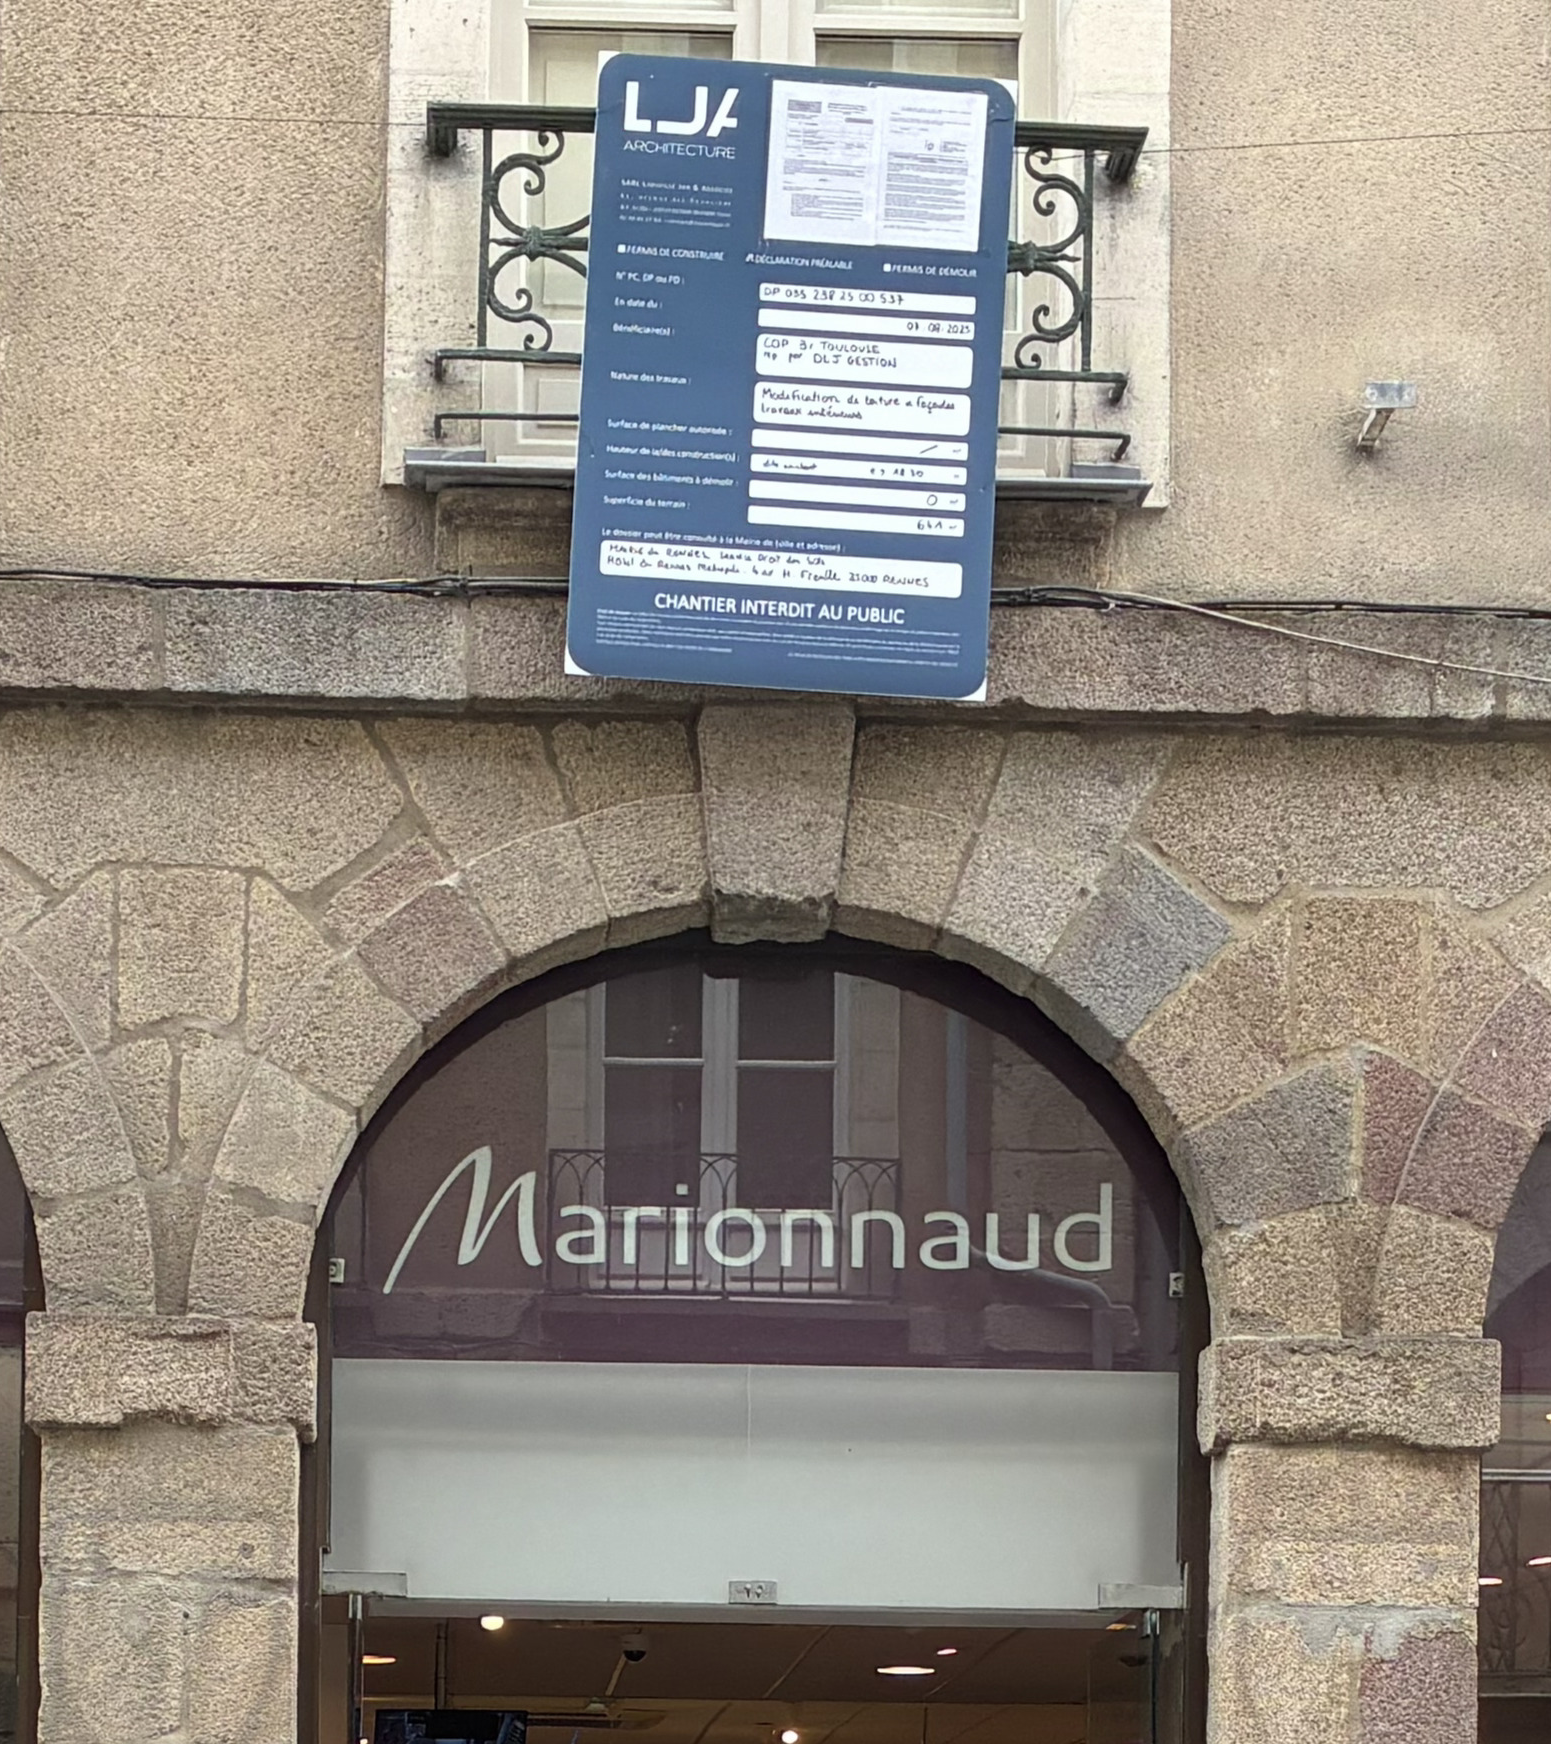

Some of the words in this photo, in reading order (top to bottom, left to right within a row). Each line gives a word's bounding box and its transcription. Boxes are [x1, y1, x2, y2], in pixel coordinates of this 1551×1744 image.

[623, 140, 736, 160] ARCHITECTURE
[847, 355, 897, 368] GESTION
[607, 418, 638, 429] Surface
[604, 470, 635, 480] Surface
[654, 593, 737, 615] CHANTIER
[740, 597, 815, 619] INTERDIT
[818, 602, 843, 621] AU
[847, 605, 905, 625] PUBLIC
[383, 1144, 1115, 1296] Marionnaud
